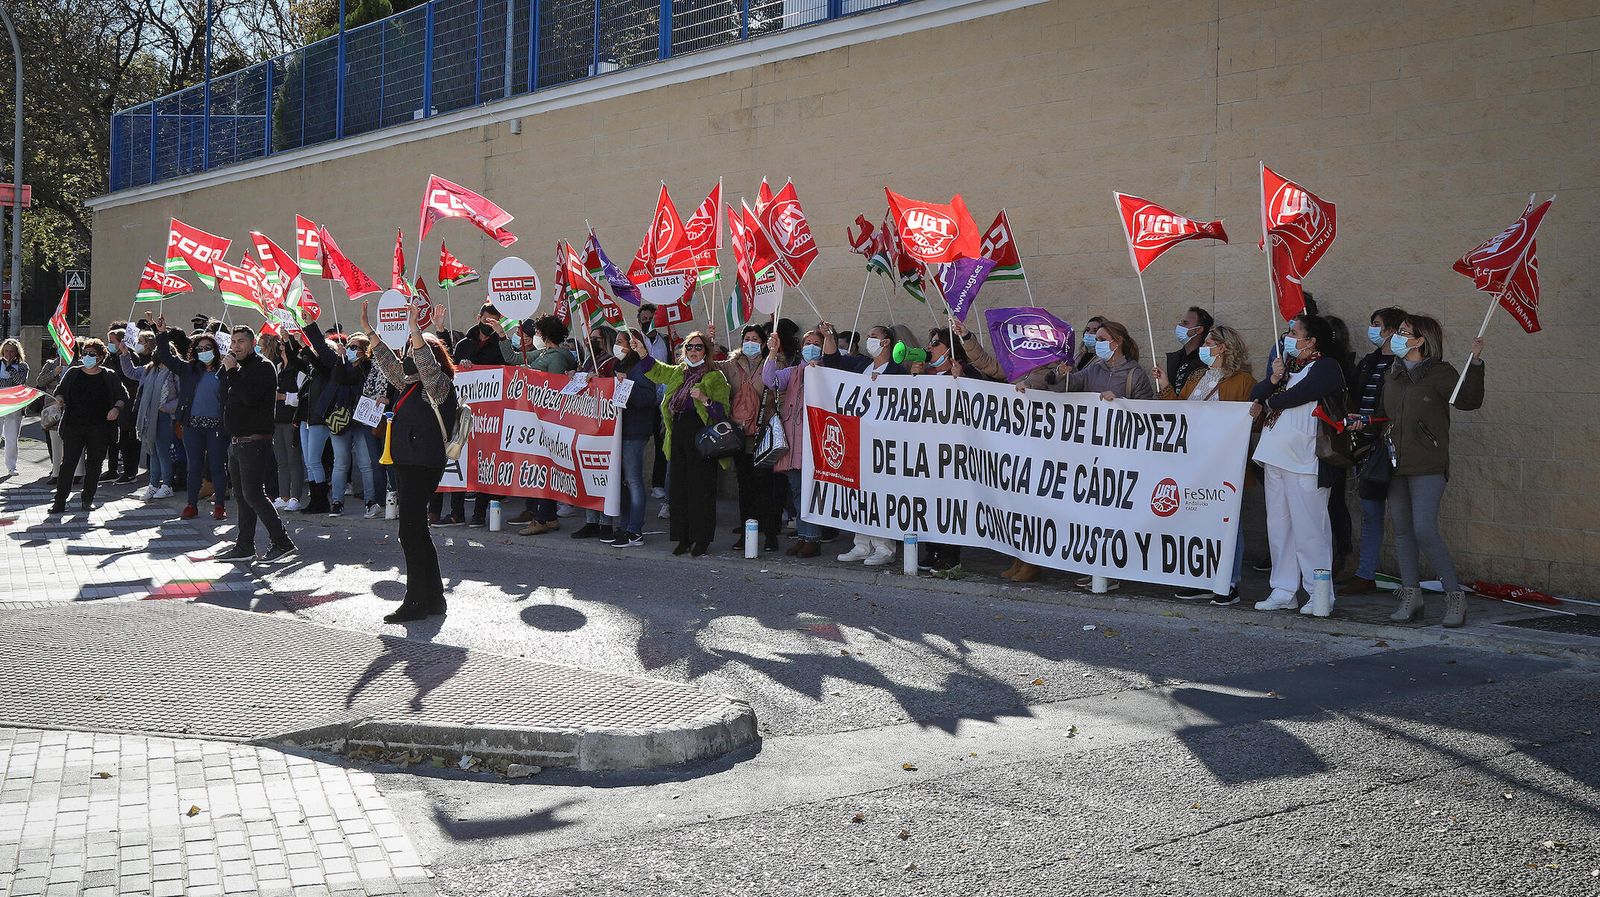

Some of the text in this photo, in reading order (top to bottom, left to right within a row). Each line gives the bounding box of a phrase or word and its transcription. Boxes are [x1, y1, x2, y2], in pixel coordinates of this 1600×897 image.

[907, 210, 951, 236] UGT
[1138, 213, 1188, 234] UGT
[169, 230, 222, 263] CCOO
[912, 244, 945, 255] SEVILLA
[493, 280, 522, 290] CCOO
[954, 264, 984, 313] www.ugt.es
[499, 292, 532, 302] hábitat
[381, 311, 398, 320] CCOO
[383, 323, 405, 332] hábitat
[1007, 323, 1057, 345] UGT
[507, 370, 524, 400] de
[835, 382, 1189, 453] LAS TRABAJADORAS/ES DE LIMPIEZA
[505, 425, 514, 449] y
[517, 426, 536, 445] se
[497, 462, 515, 486] en
[519, 460, 548, 490] tus
[872, 438, 1139, 510] DE LA PROVINCIA DE CÁDIZ
[1155, 484, 1177, 500] UGT
[1184, 488, 1226, 502] FeSMC
[831, 485, 880, 527] LUCHA
[886, 493, 928, 532] POR
[936, 497, 968, 536] UN
[976, 501, 1057, 557] CONVENIO
[1061, 522, 1128, 569] JUSTO
[1134, 531, 1152, 571] Y
